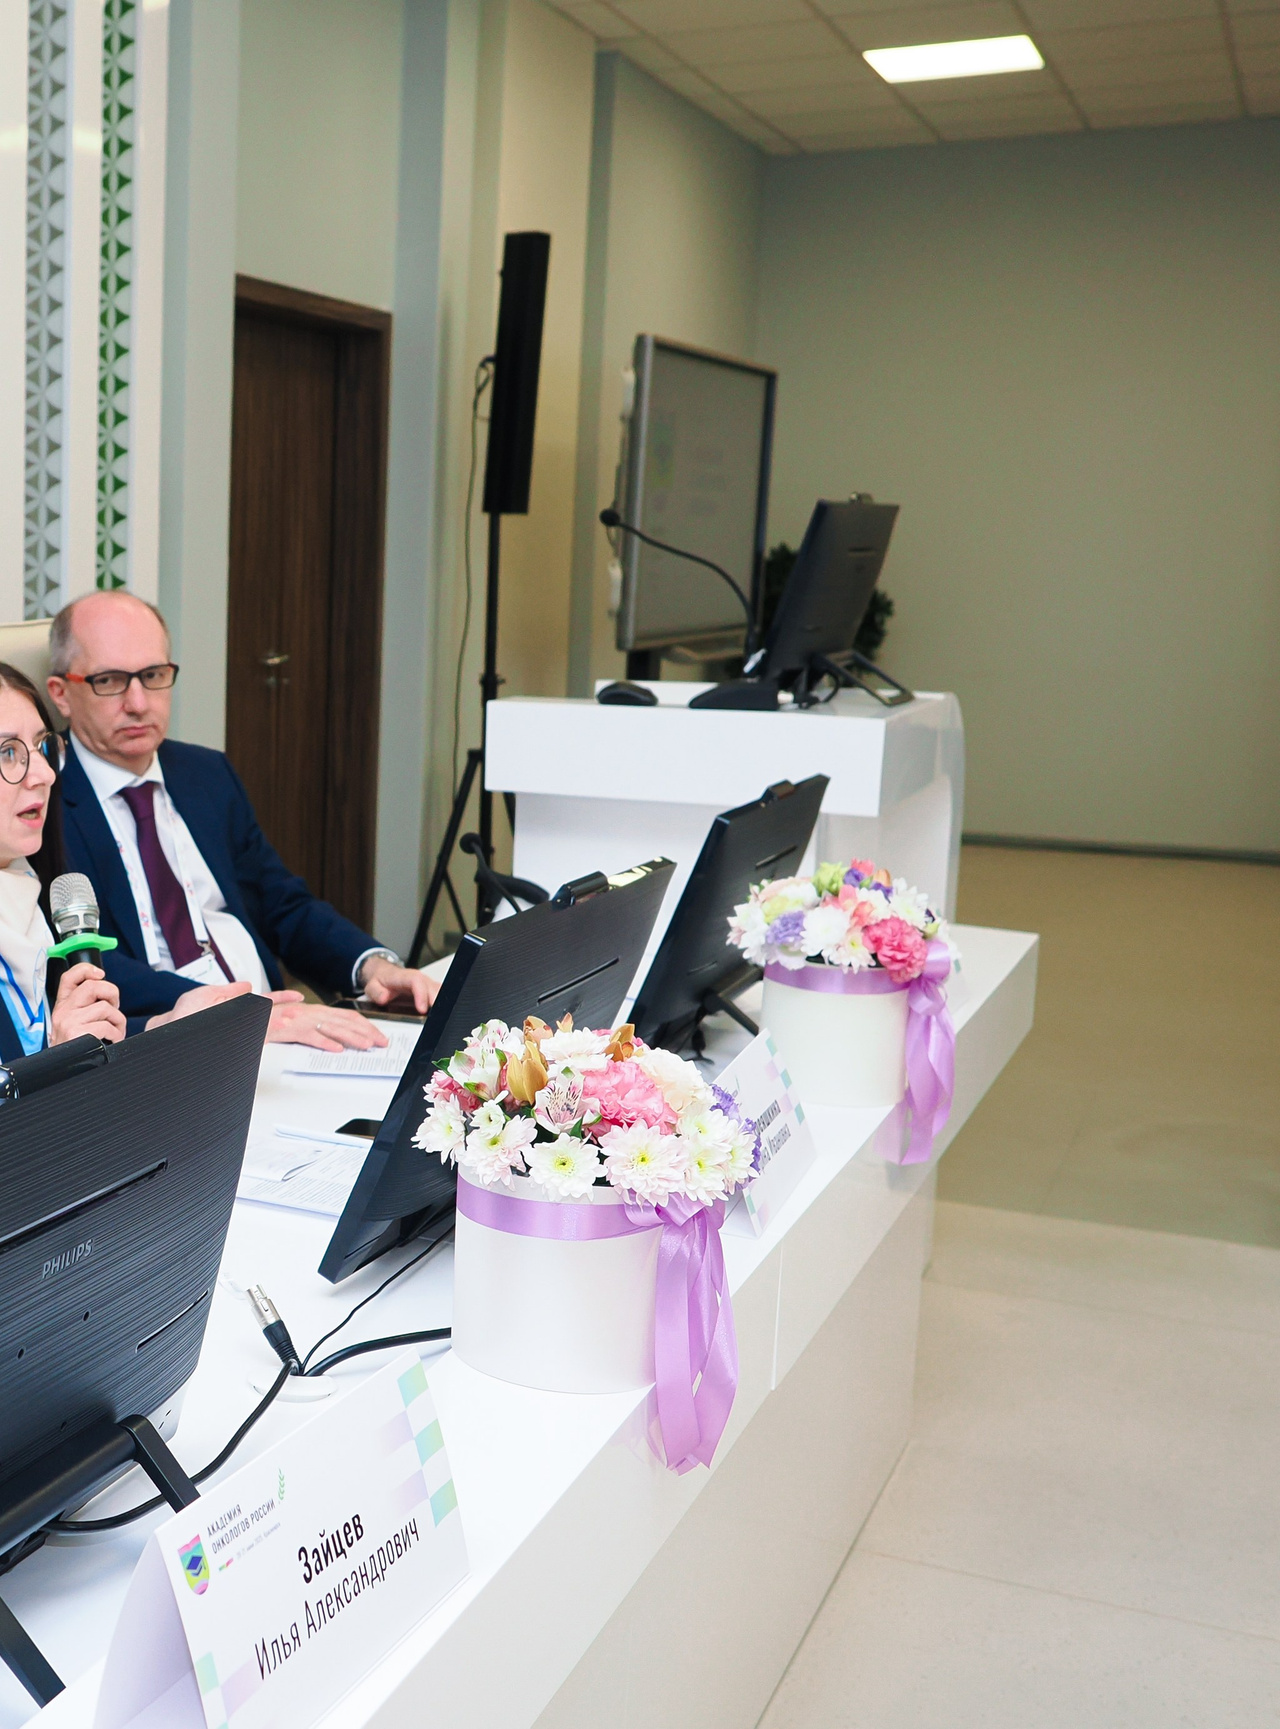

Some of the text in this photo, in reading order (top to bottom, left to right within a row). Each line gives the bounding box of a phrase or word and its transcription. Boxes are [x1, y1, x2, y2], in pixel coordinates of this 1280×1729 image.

[42, 1239, 93, 1279] PHILIPS
[206, 1503, 242, 1538] АКАДЕМИЯ
[211, 1517, 251, 1555] ОНКОЛОГОВ
[250, 1498, 276, 1525] РОССИИ
[297, 1513, 365, 1584] Зайцев
[254, 1622, 302, 1681] Илья
[304, 1517, 421, 1639] Александрович
